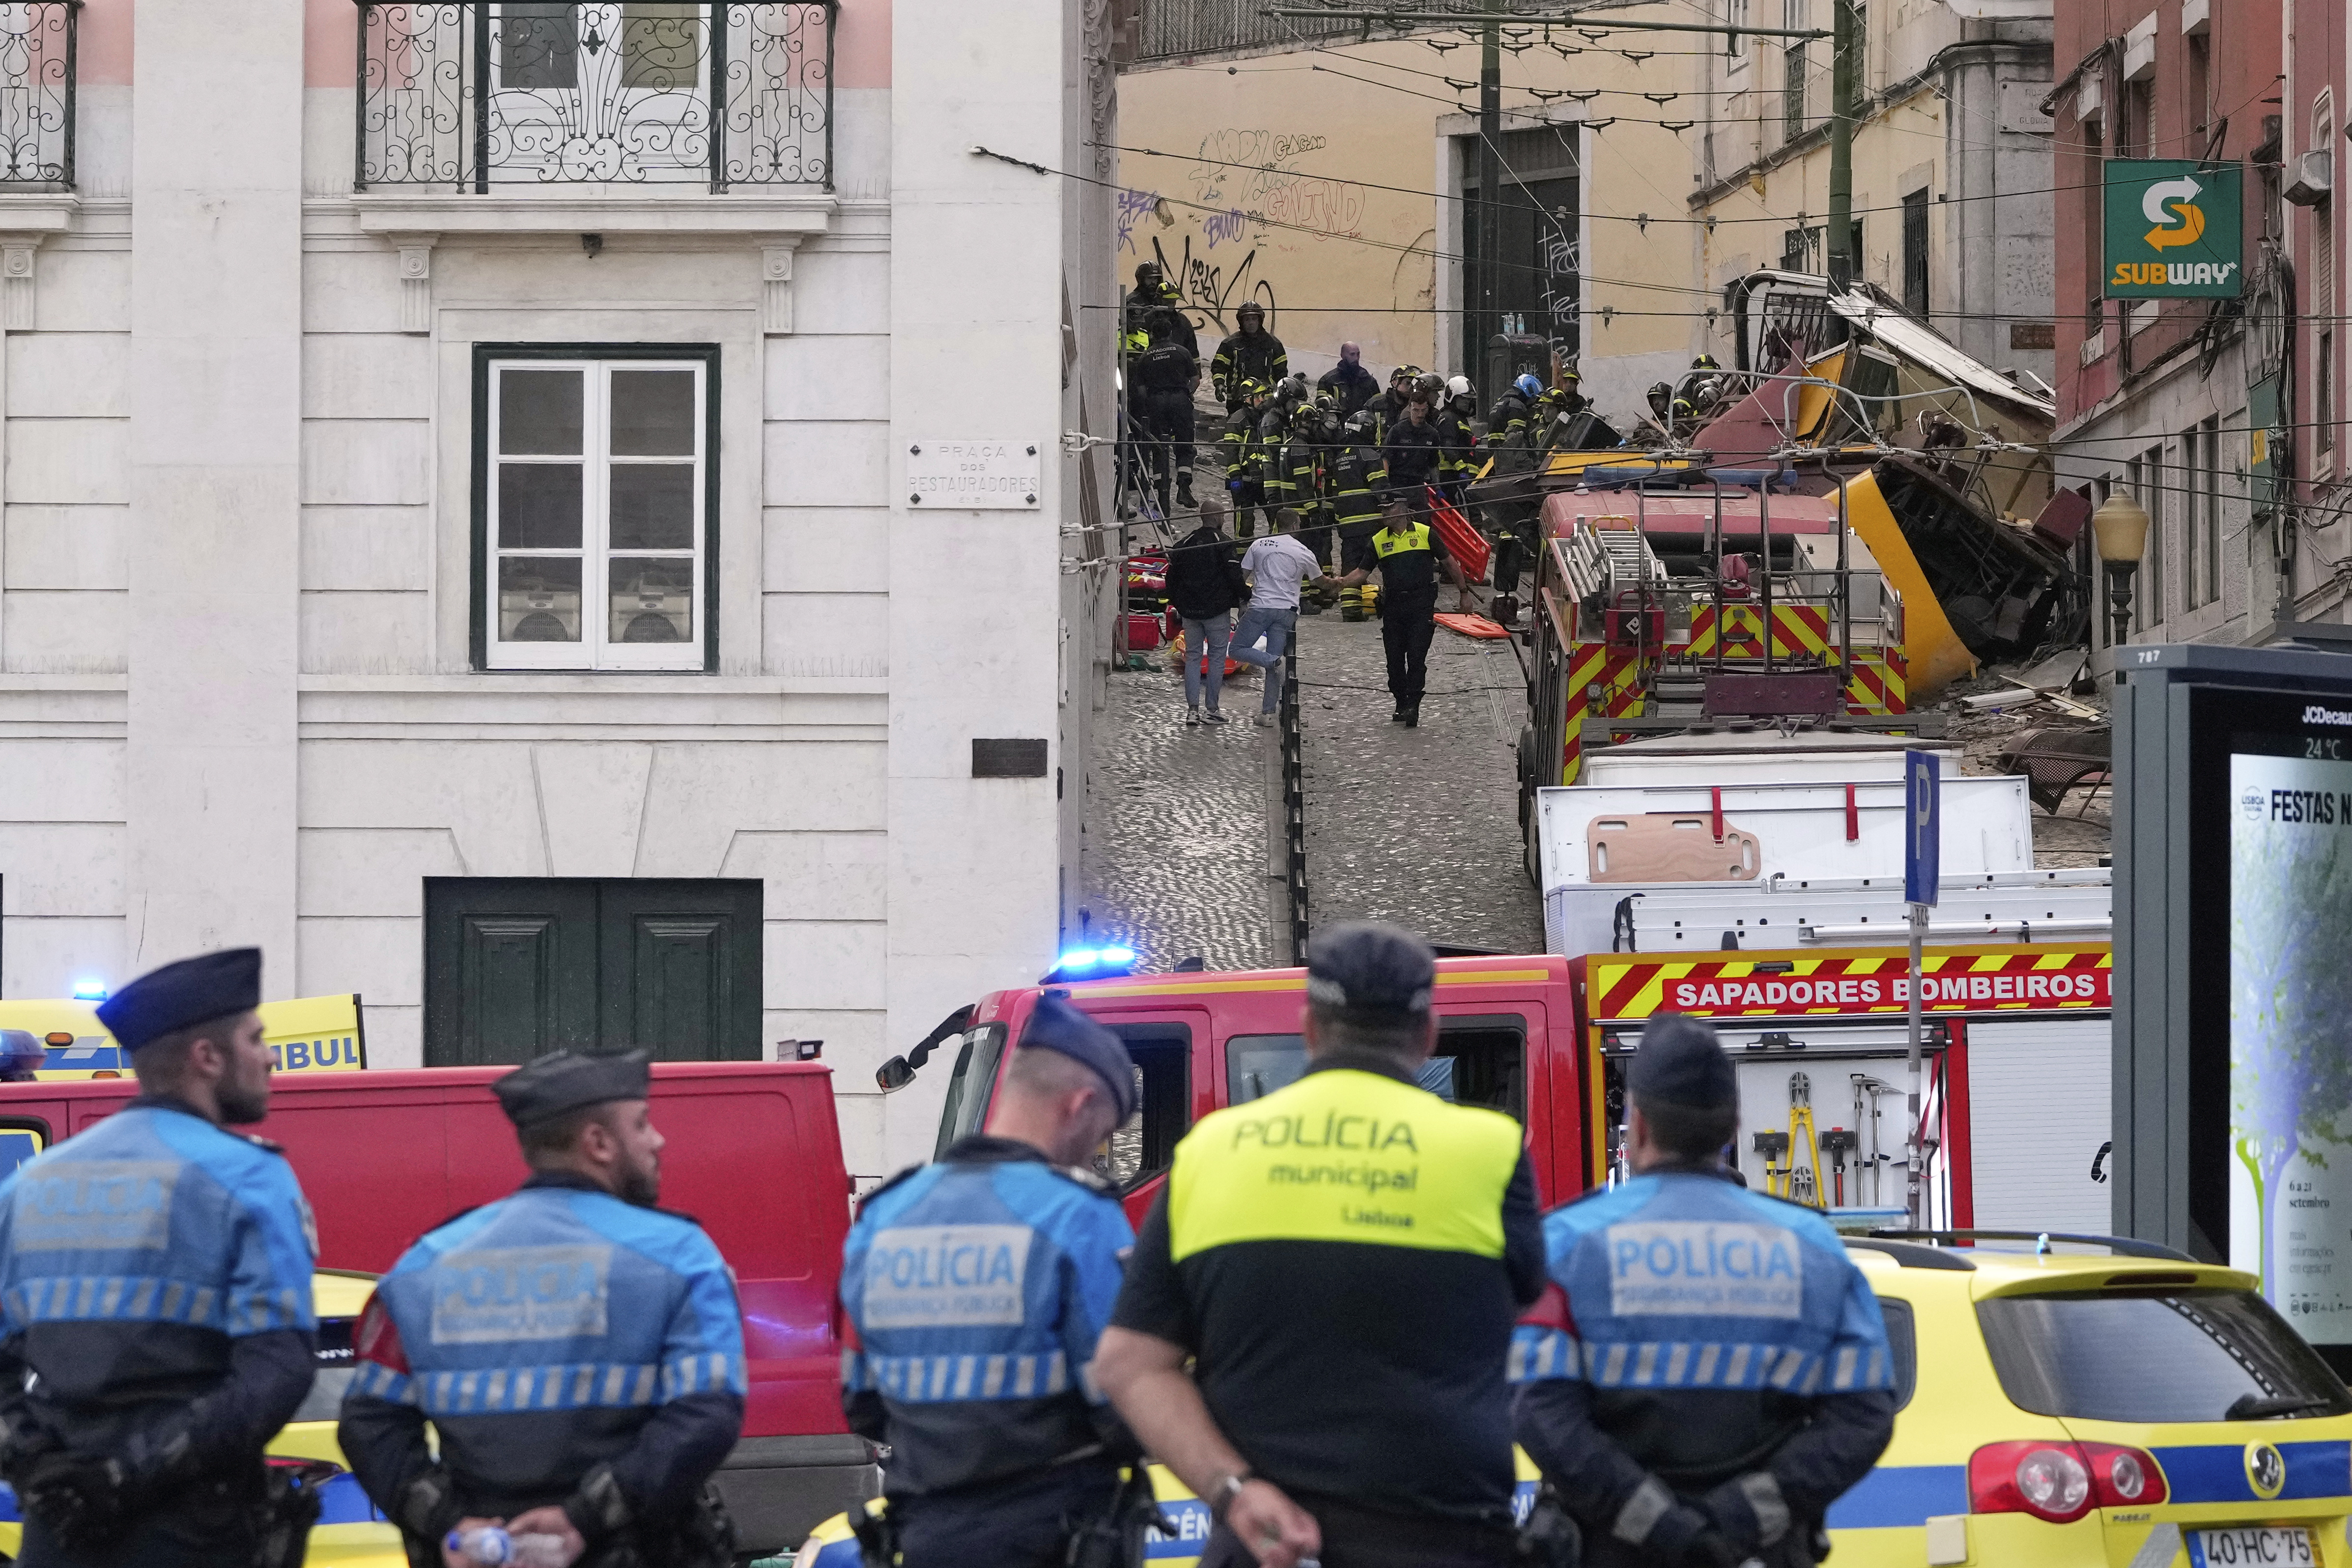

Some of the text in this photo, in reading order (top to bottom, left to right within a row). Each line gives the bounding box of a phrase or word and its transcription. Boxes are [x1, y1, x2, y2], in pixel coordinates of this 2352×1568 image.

[1273, 134, 1326, 161] GAGAN
[2111, 261, 2238, 286] SUBWAY
[939, 446, 1006, 462] PRAÇA
[909, 477, 1038, 492] RESTAURADORES
[2306, 738, 2323, 759] 24
[1916, 763, 1931, 859] P
[2272, 790, 2334, 824] FESTAS
[1676, 979, 1881, 1007] SAPADORES
[1894, 973, 2096, 1002] BOMBEIROS
[1230, 1108, 1419, 1153] POLÍCIA
[1268, 1161, 1419, 1198] municipal
[2290, 1196, 2330, 1208] setembro
[1617, 1227, 1795, 1279] POLÍCIA
